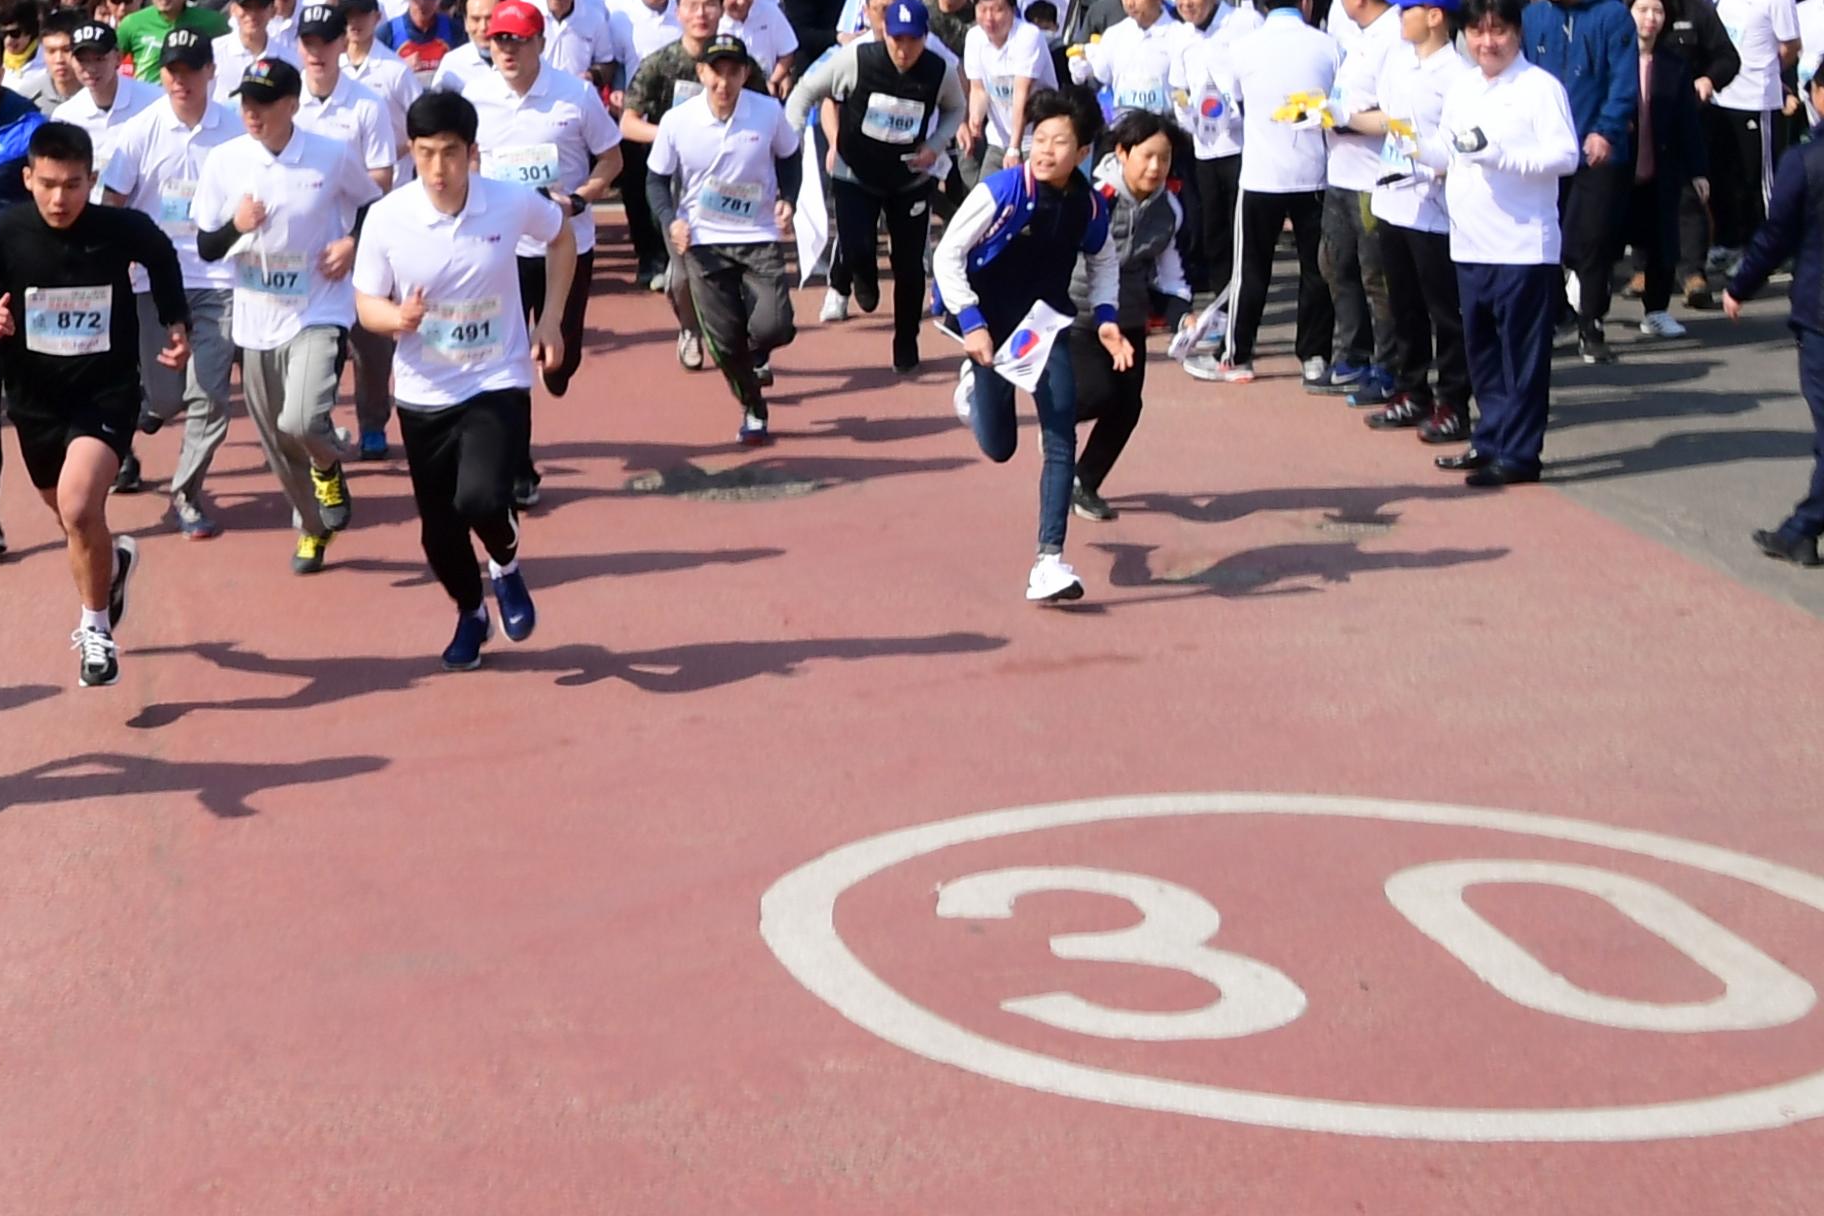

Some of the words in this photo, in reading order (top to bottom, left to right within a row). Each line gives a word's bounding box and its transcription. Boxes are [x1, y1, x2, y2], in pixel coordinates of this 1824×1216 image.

[73, 27, 105, 44] SDT
[168, 30, 199, 48] SDT
[519, 164, 551, 182] 301
[57, 311, 102, 329] 872
[451, 319, 490, 342] 491
[934, 857, 1818, 1043] 30
